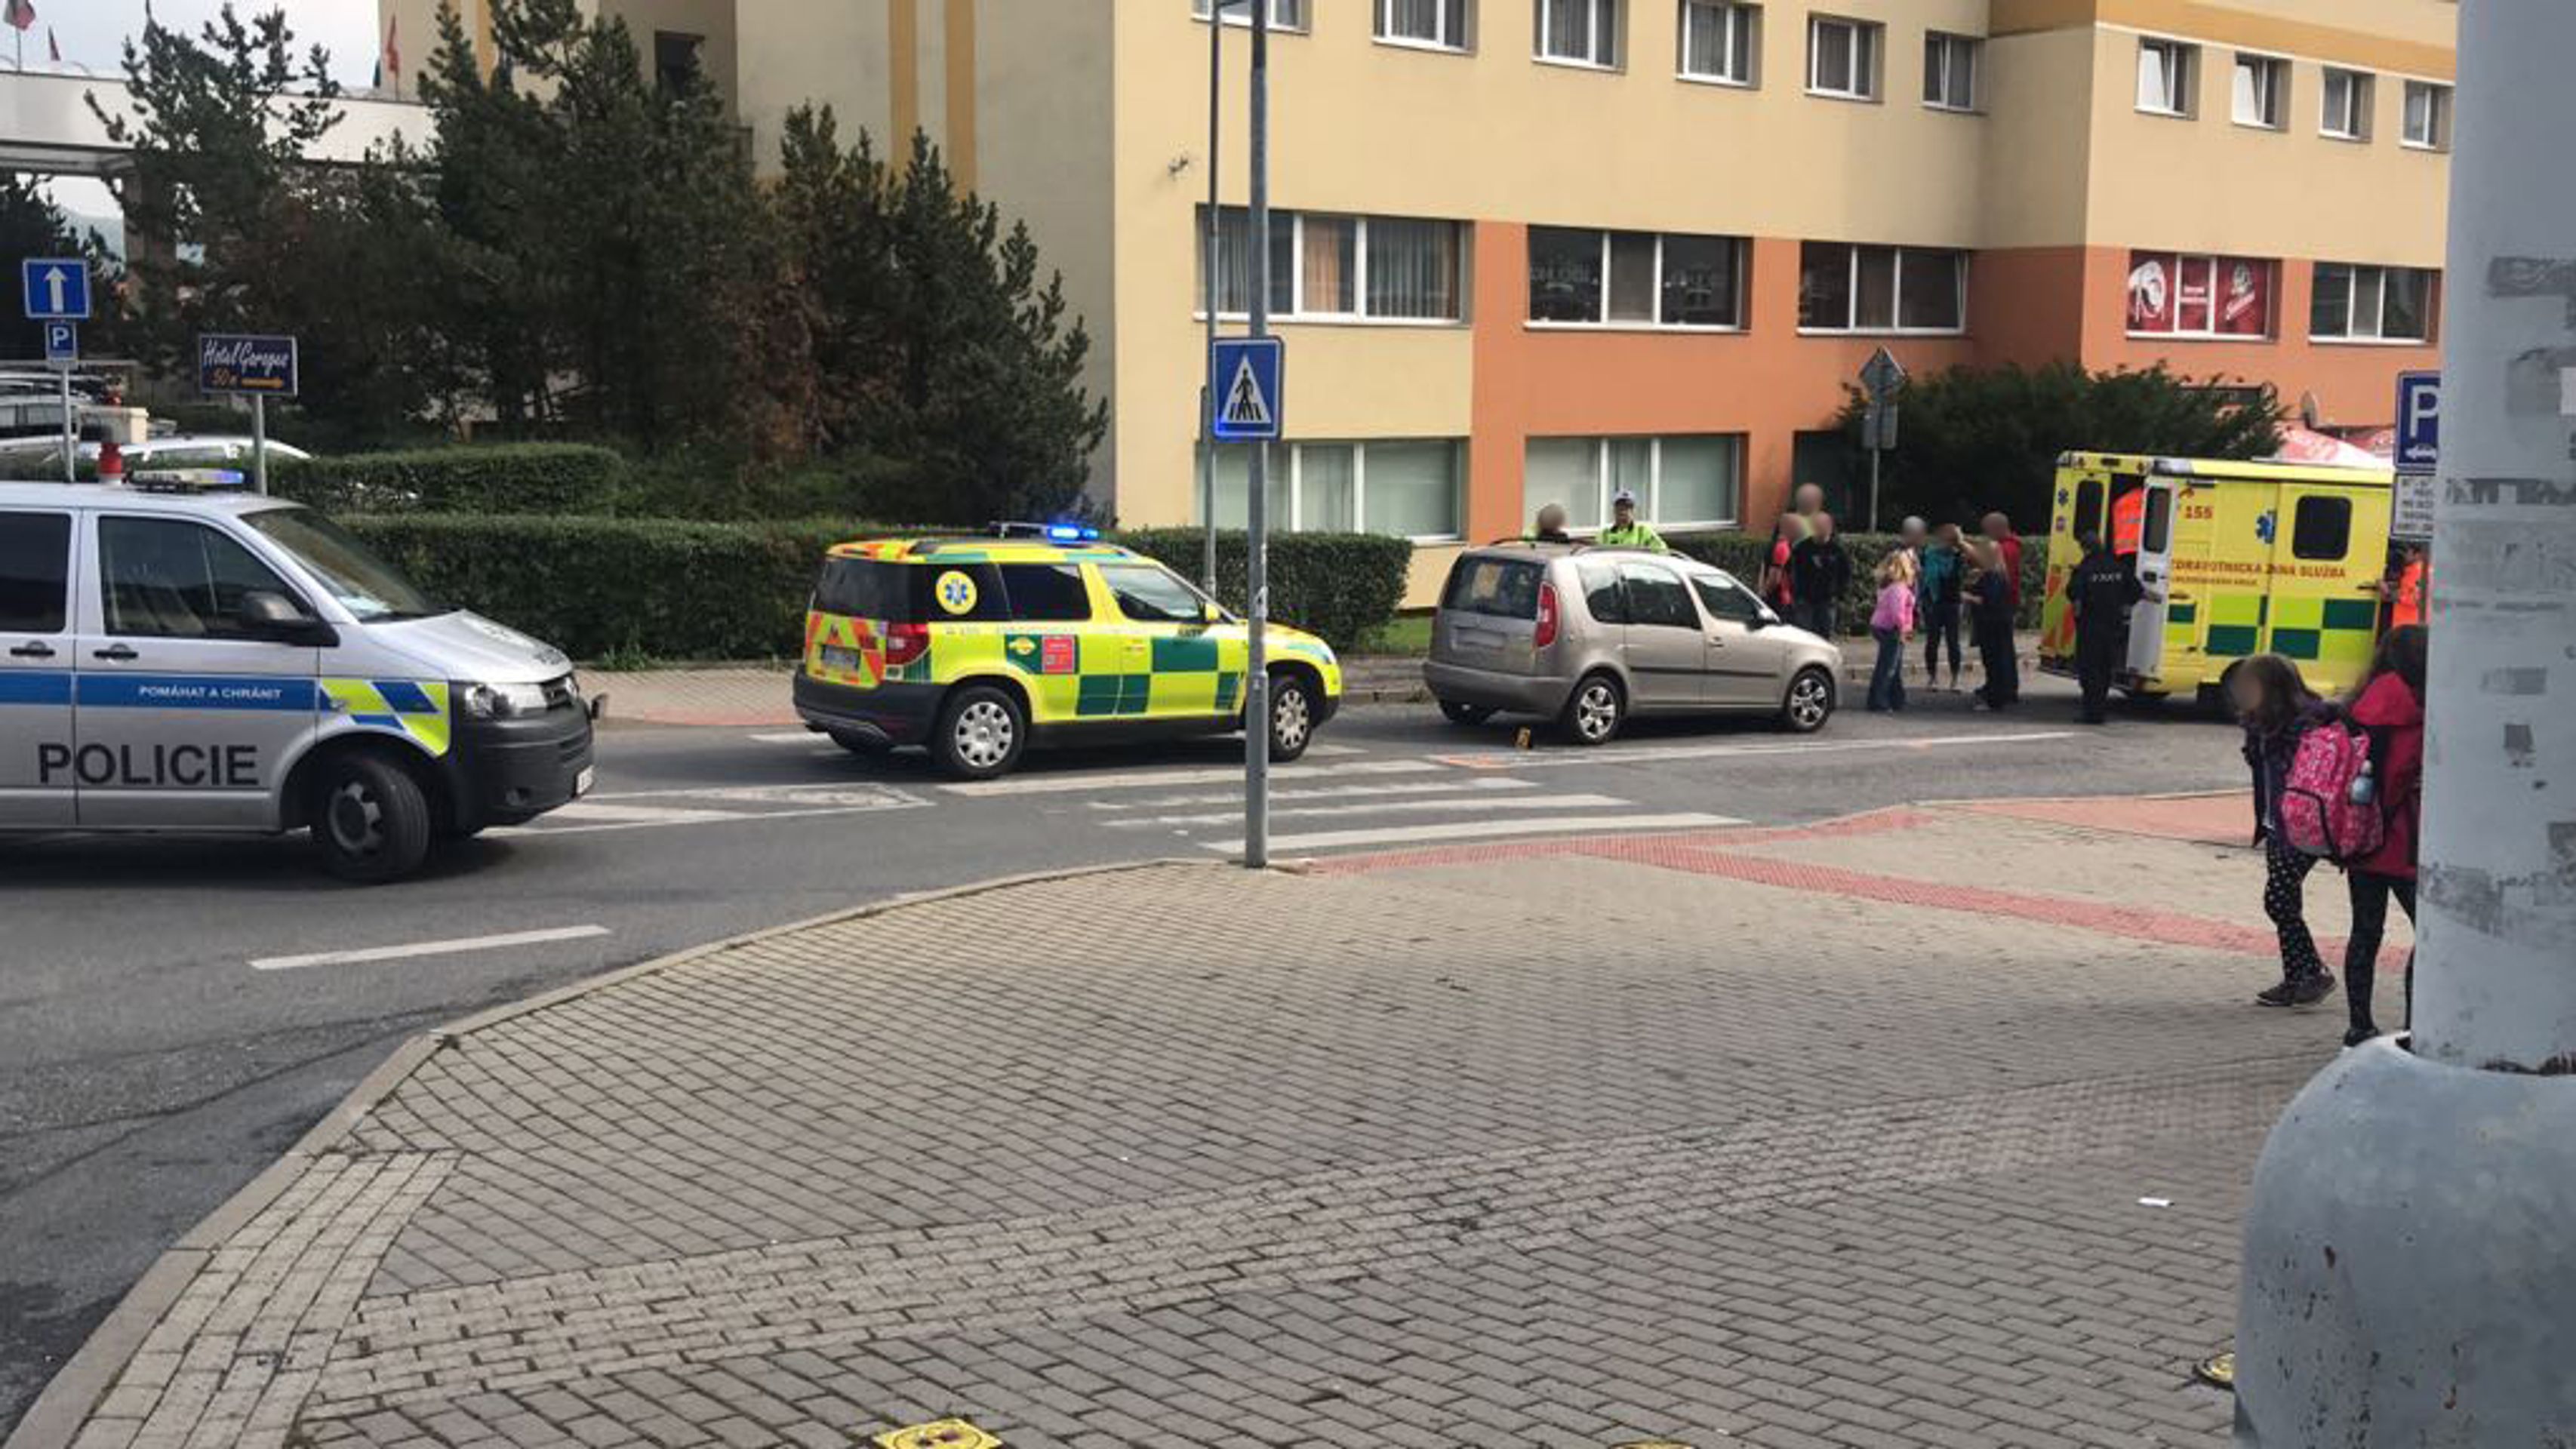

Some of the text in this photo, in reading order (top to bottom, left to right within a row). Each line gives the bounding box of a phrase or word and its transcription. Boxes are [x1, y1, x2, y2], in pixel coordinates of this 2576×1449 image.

[52, 326, 69, 348] P
[2409, 384, 2439, 438] P
[2185, 505, 2213, 520] 155
[139, 684, 283, 700] POMÁHAT A CHRÁNIT
[38, 743, 260, 786] POLICIE
